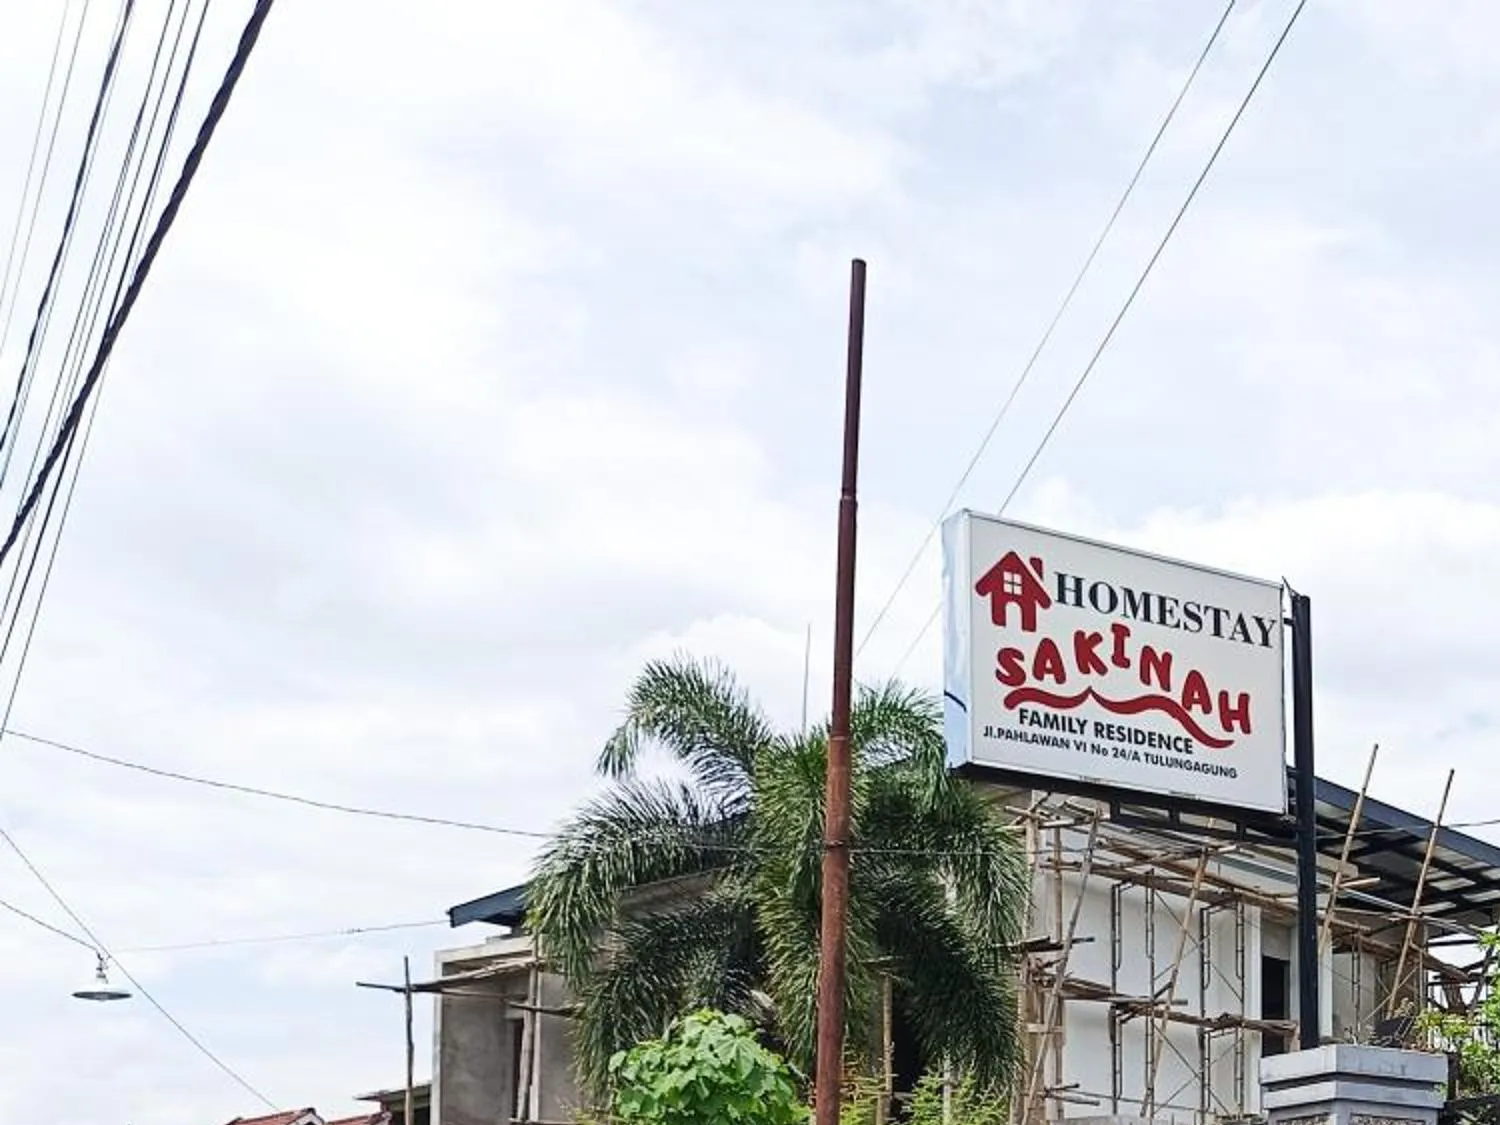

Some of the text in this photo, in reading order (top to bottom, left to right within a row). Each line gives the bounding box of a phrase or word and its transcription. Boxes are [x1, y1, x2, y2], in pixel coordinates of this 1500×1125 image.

[1054, 572, 1277, 649] HOMESTAY
[995, 622, 1252, 735] SAKINAH
[1018, 708, 1193, 754] FAMILY RESIDENCE
[1074, 739, 1087, 753] VI
[1091, 742, 1109, 757] No
[1112, 747, 1140, 763] 24/A
[1143, 752, 1238, 779] TULUNGAGUNG
